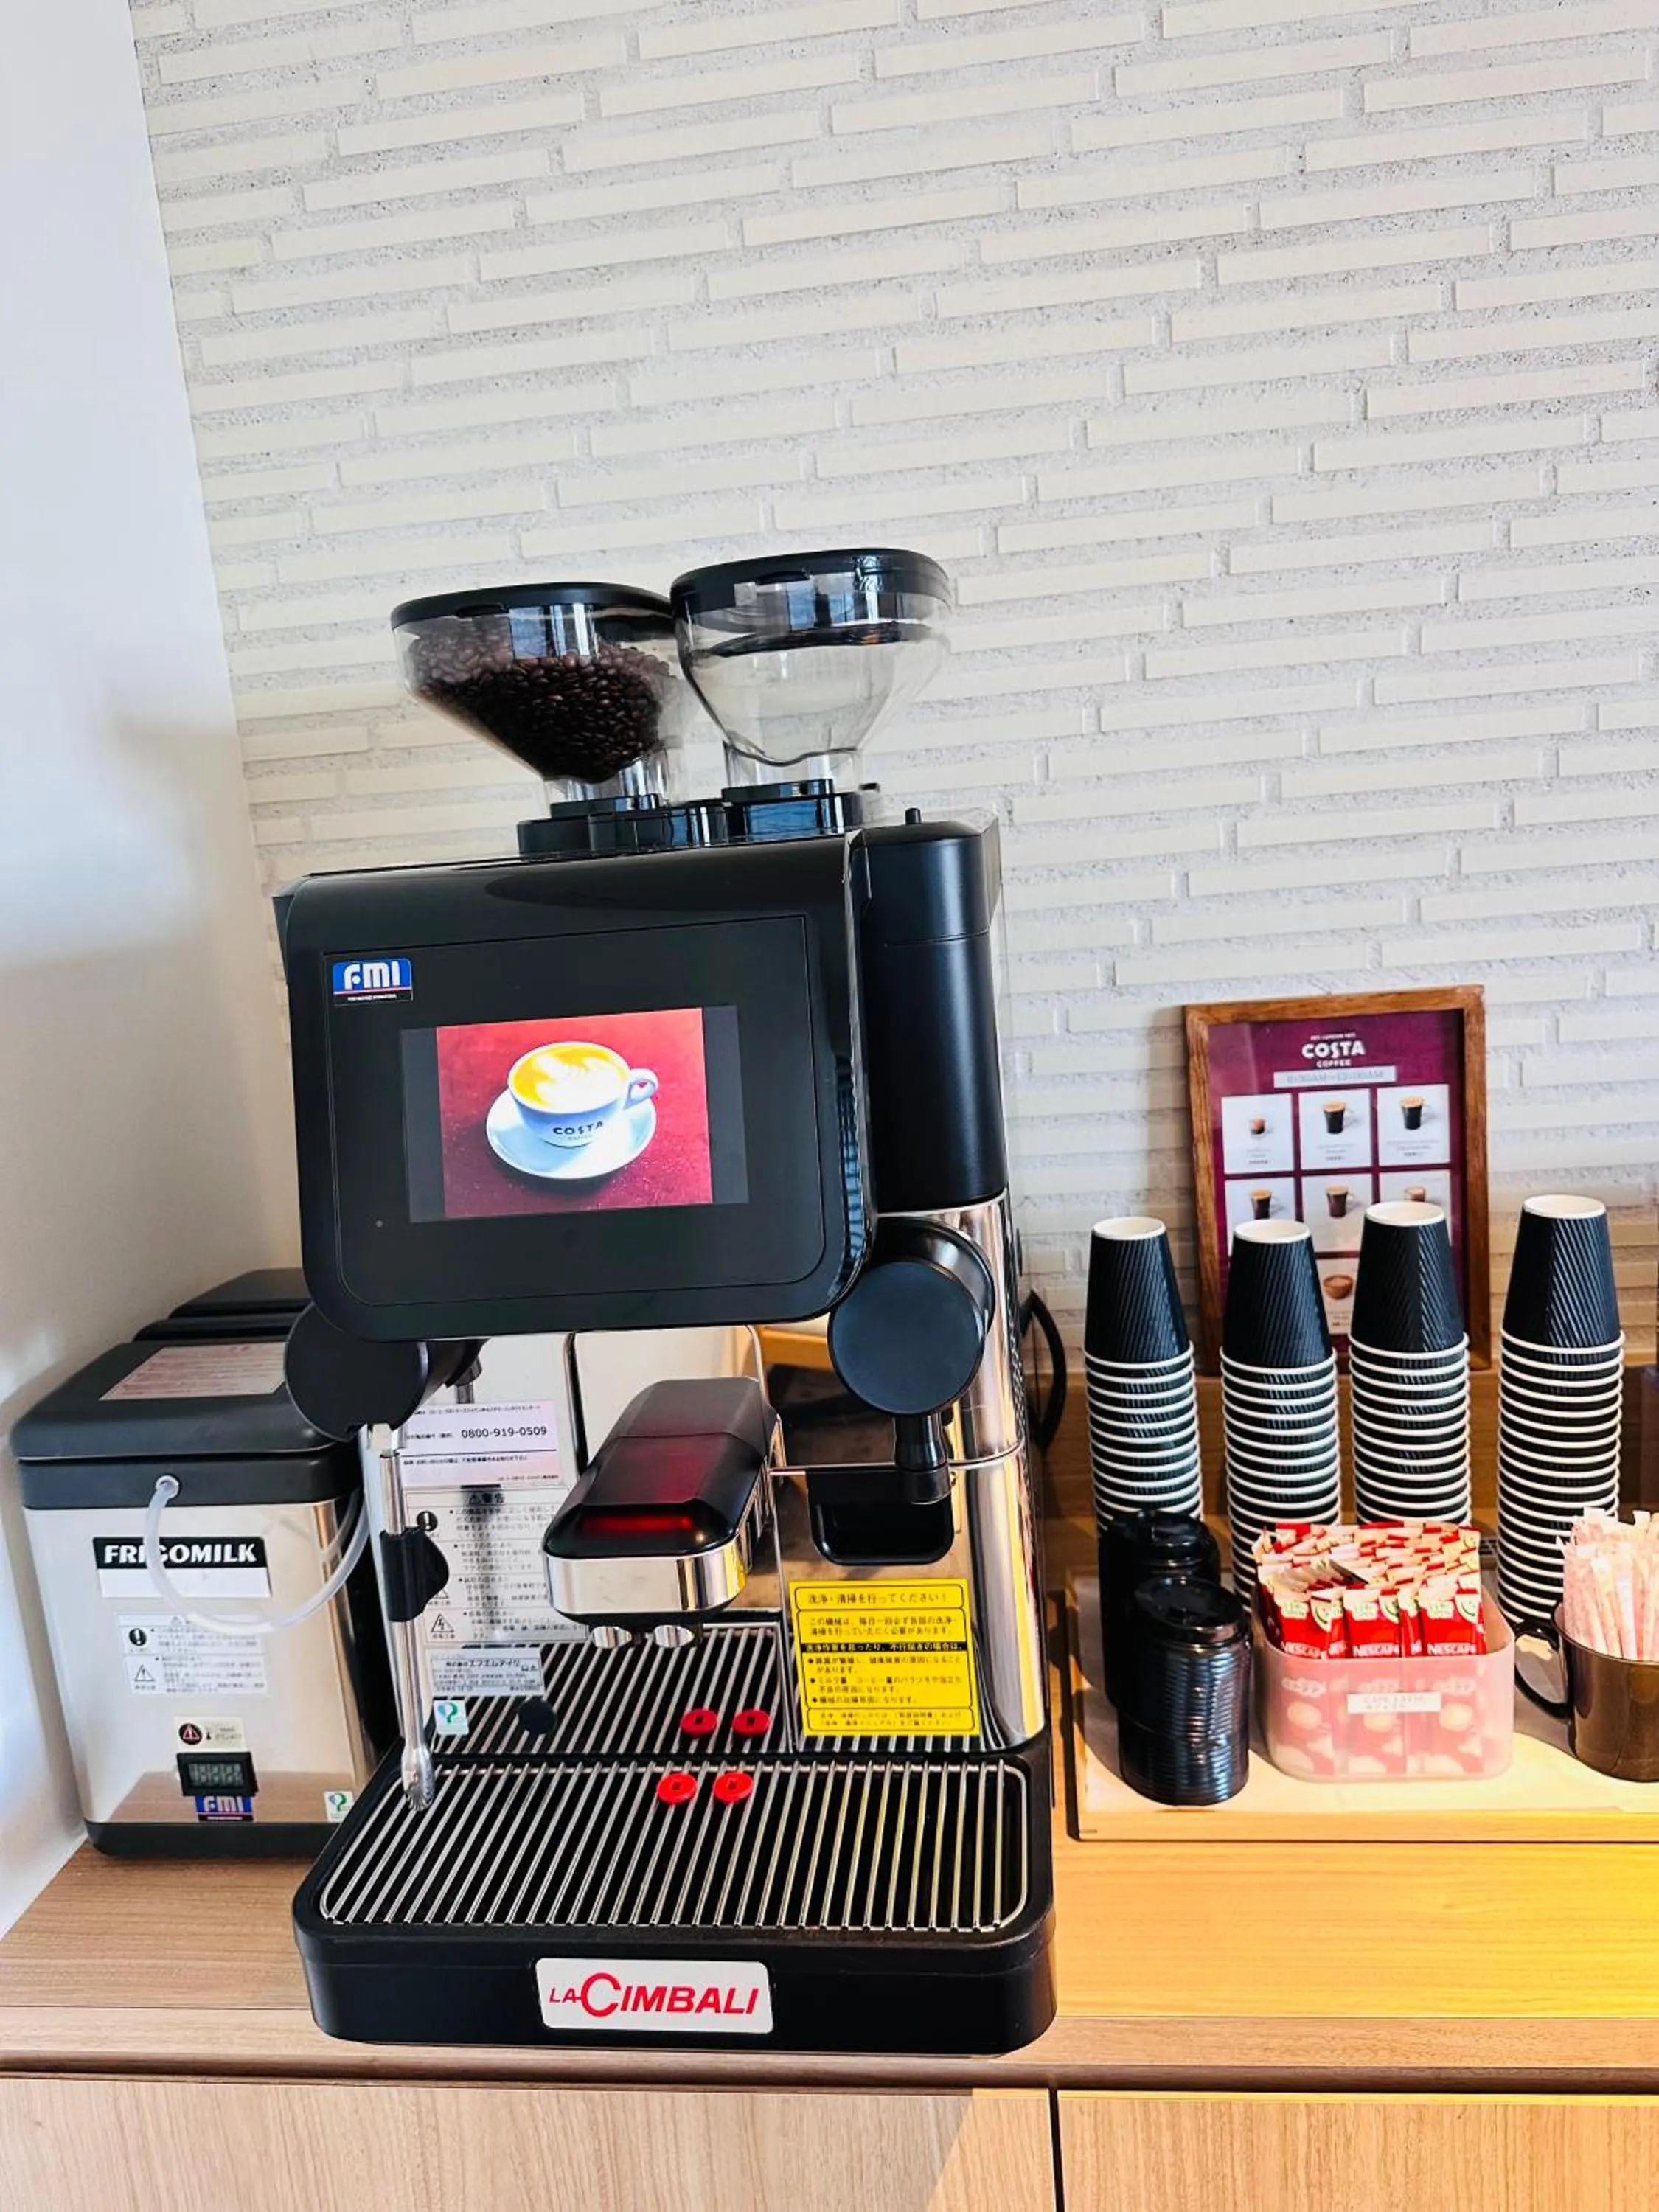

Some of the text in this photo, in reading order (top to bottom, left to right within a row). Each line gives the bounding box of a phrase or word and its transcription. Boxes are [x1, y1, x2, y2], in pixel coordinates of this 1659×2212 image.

[1301, 1040, 1366, 1059] COSTA
[1316, 1059, 1352, 1068] COFFEE
[552, 1121, 603, 1135] COSTA
[461, 1425, 547, 1439] 0800-919-0509
[549, 1972, 759, 2018] LA CIMBALI
